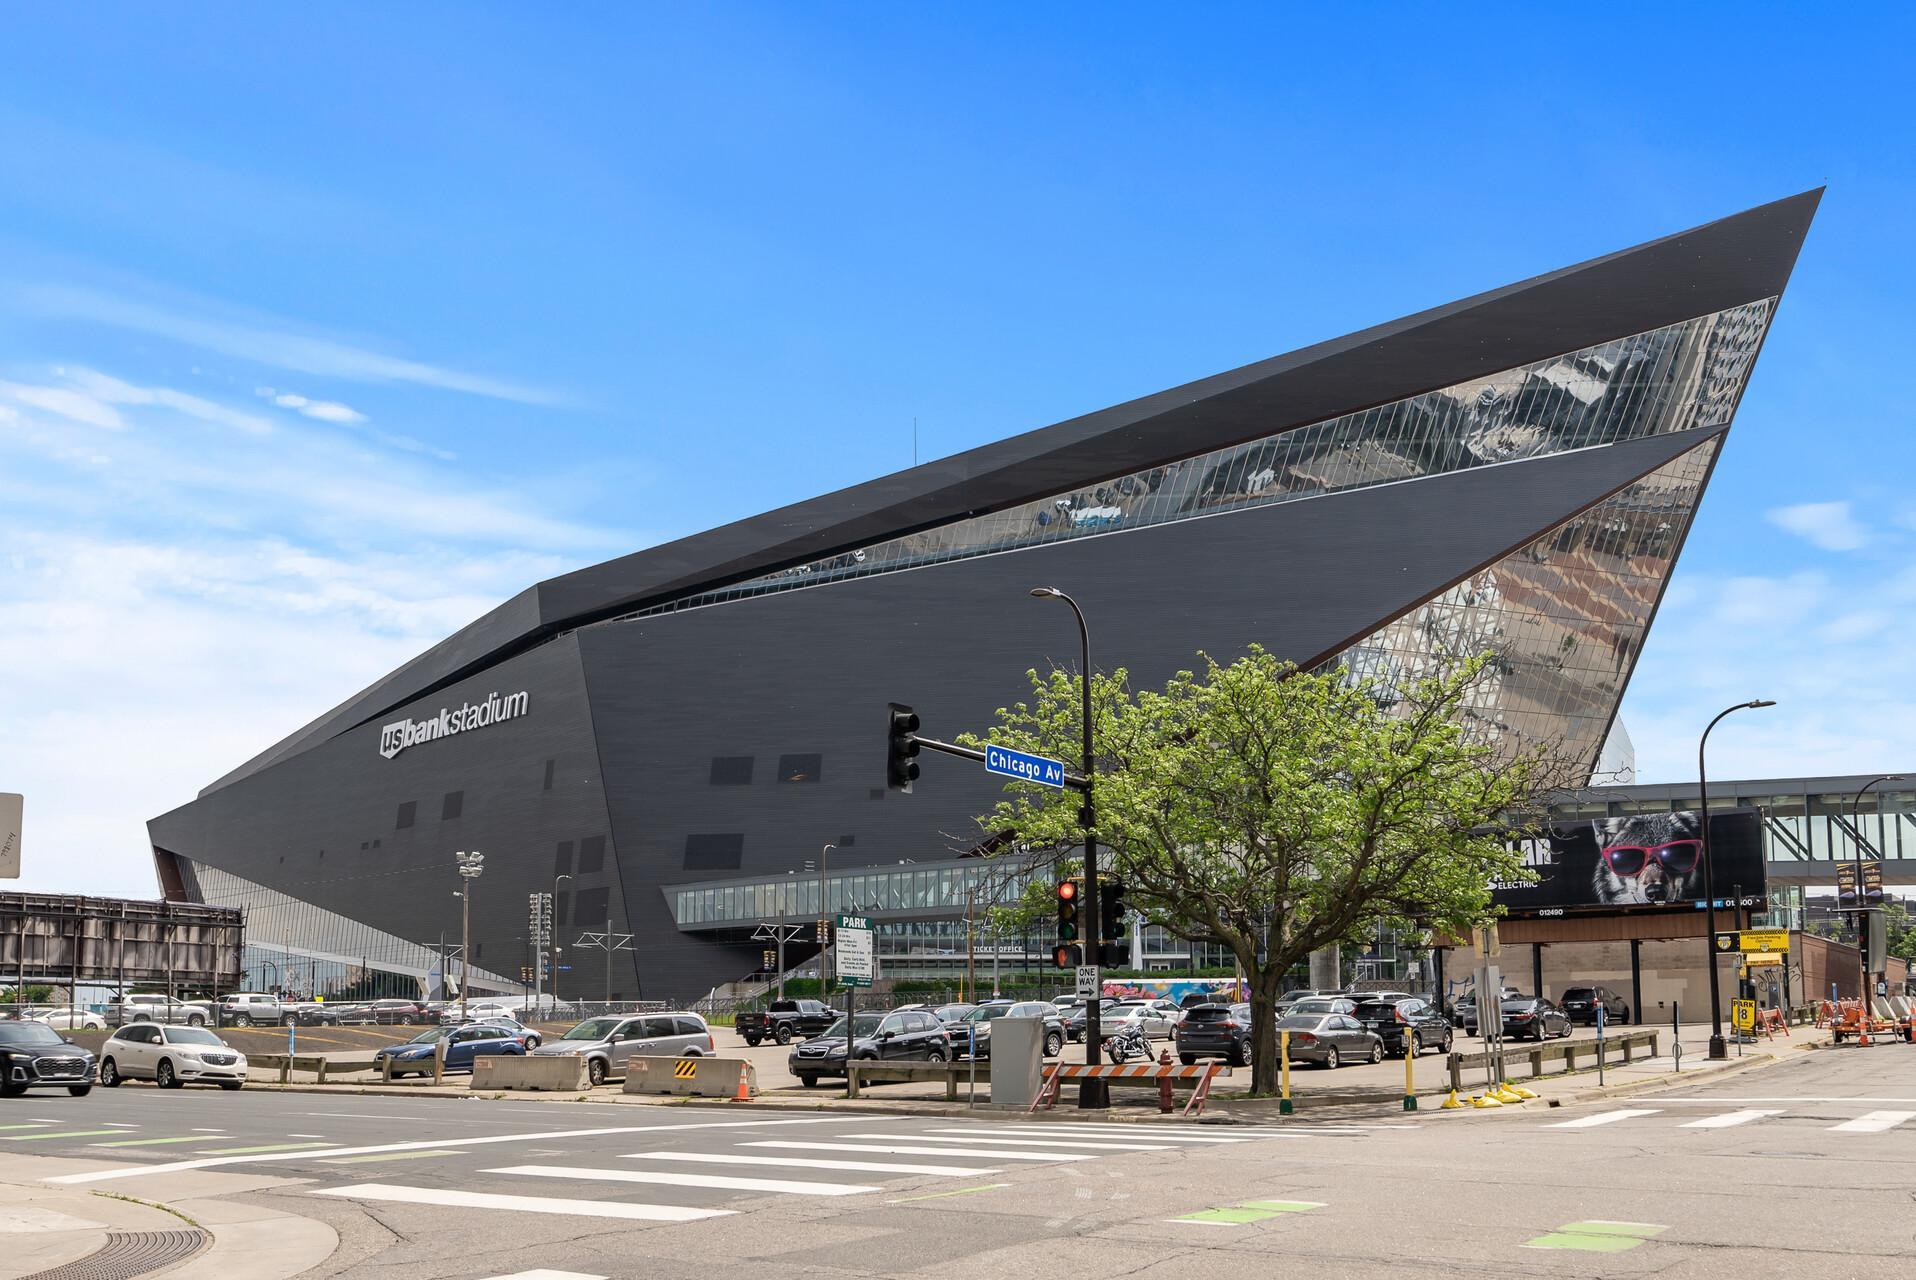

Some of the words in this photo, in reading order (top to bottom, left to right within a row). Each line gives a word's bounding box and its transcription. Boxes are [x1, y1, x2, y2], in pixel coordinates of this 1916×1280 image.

[990, 751, 1040, 779] Chicago
[1046, 765, 1061, 781] Av
[1498, 881, 1539, 890] ELECTRIC
[1539, 908, 1564, 916] 012490
[842, 916, 867, 929] PARK
[1079, 968, 1096, 977] ONE
[1079, 977, 1096, 986] WAY
